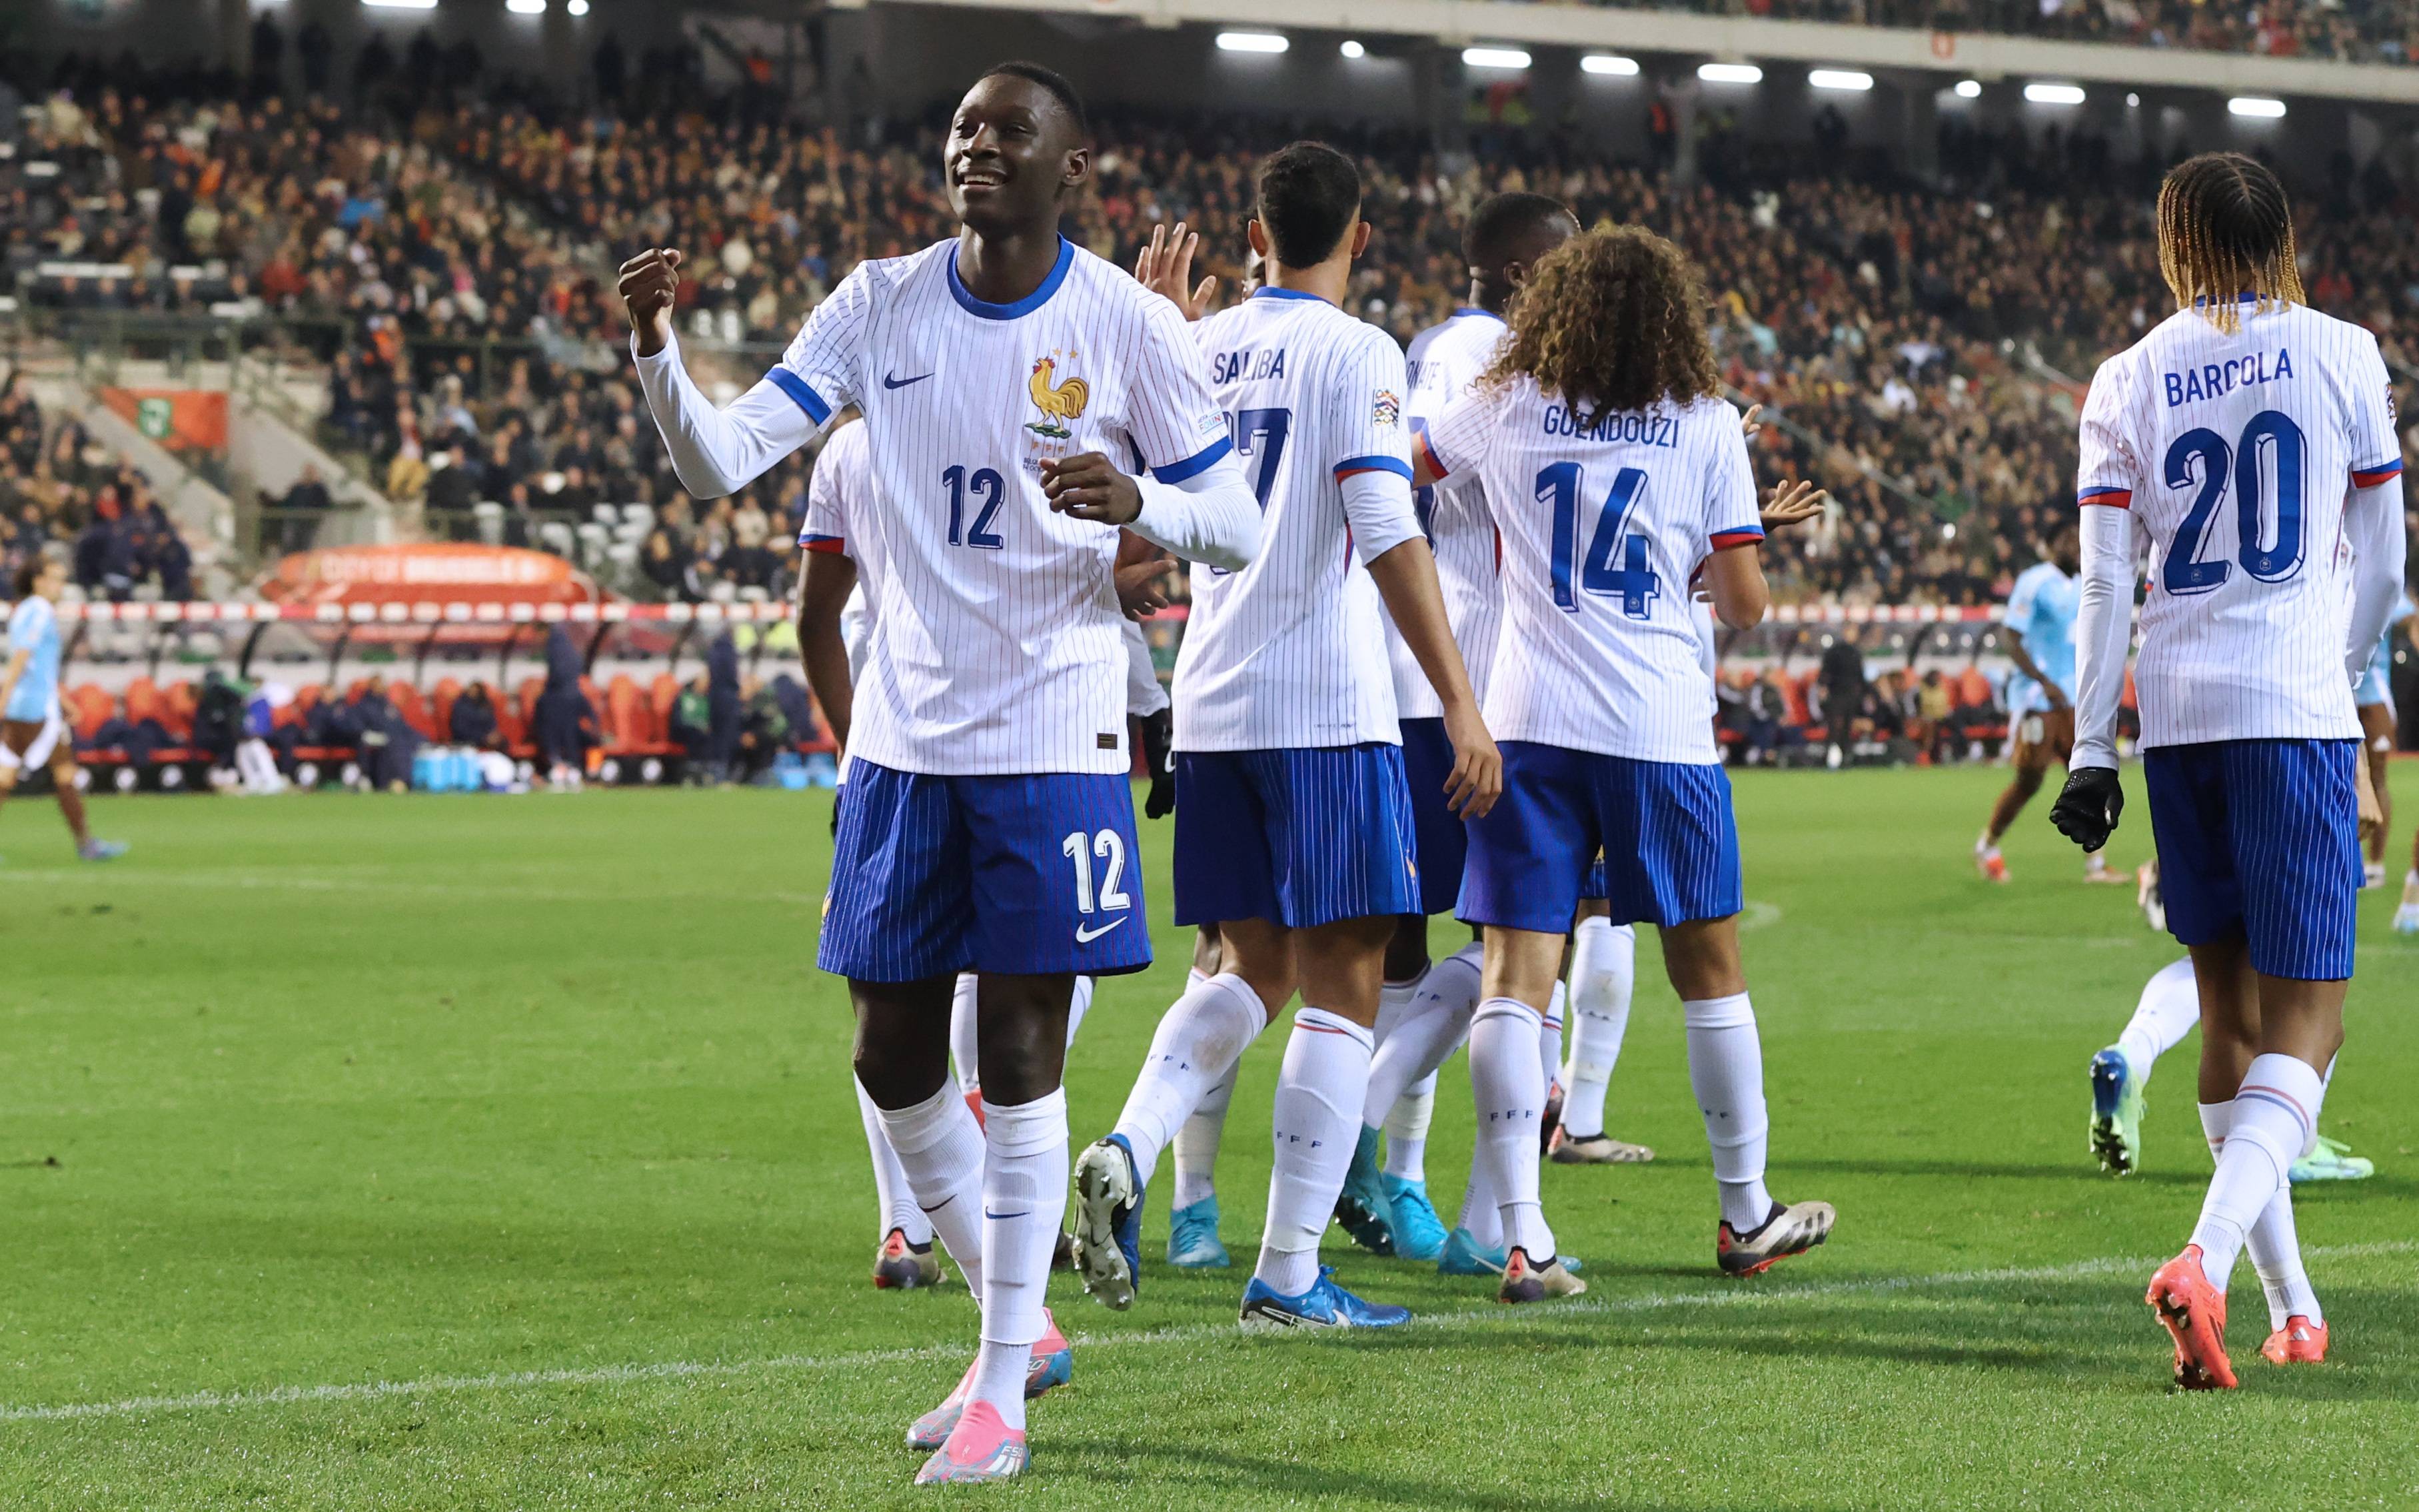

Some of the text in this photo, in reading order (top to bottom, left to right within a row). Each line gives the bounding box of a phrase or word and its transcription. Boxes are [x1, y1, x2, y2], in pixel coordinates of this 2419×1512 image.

[1213, 349, 1285, 384] SALIBA
[2165, 349, 2293, 407] BARCOLA
[1544, 405, 1679, 448] GUENDOUZI
[943, 465, 1005, 549] 12
[1535, 461, 1661, 620] 14
[2163, 410, 2307, 595] 20
[1063, 829, 1130, 914] 12
